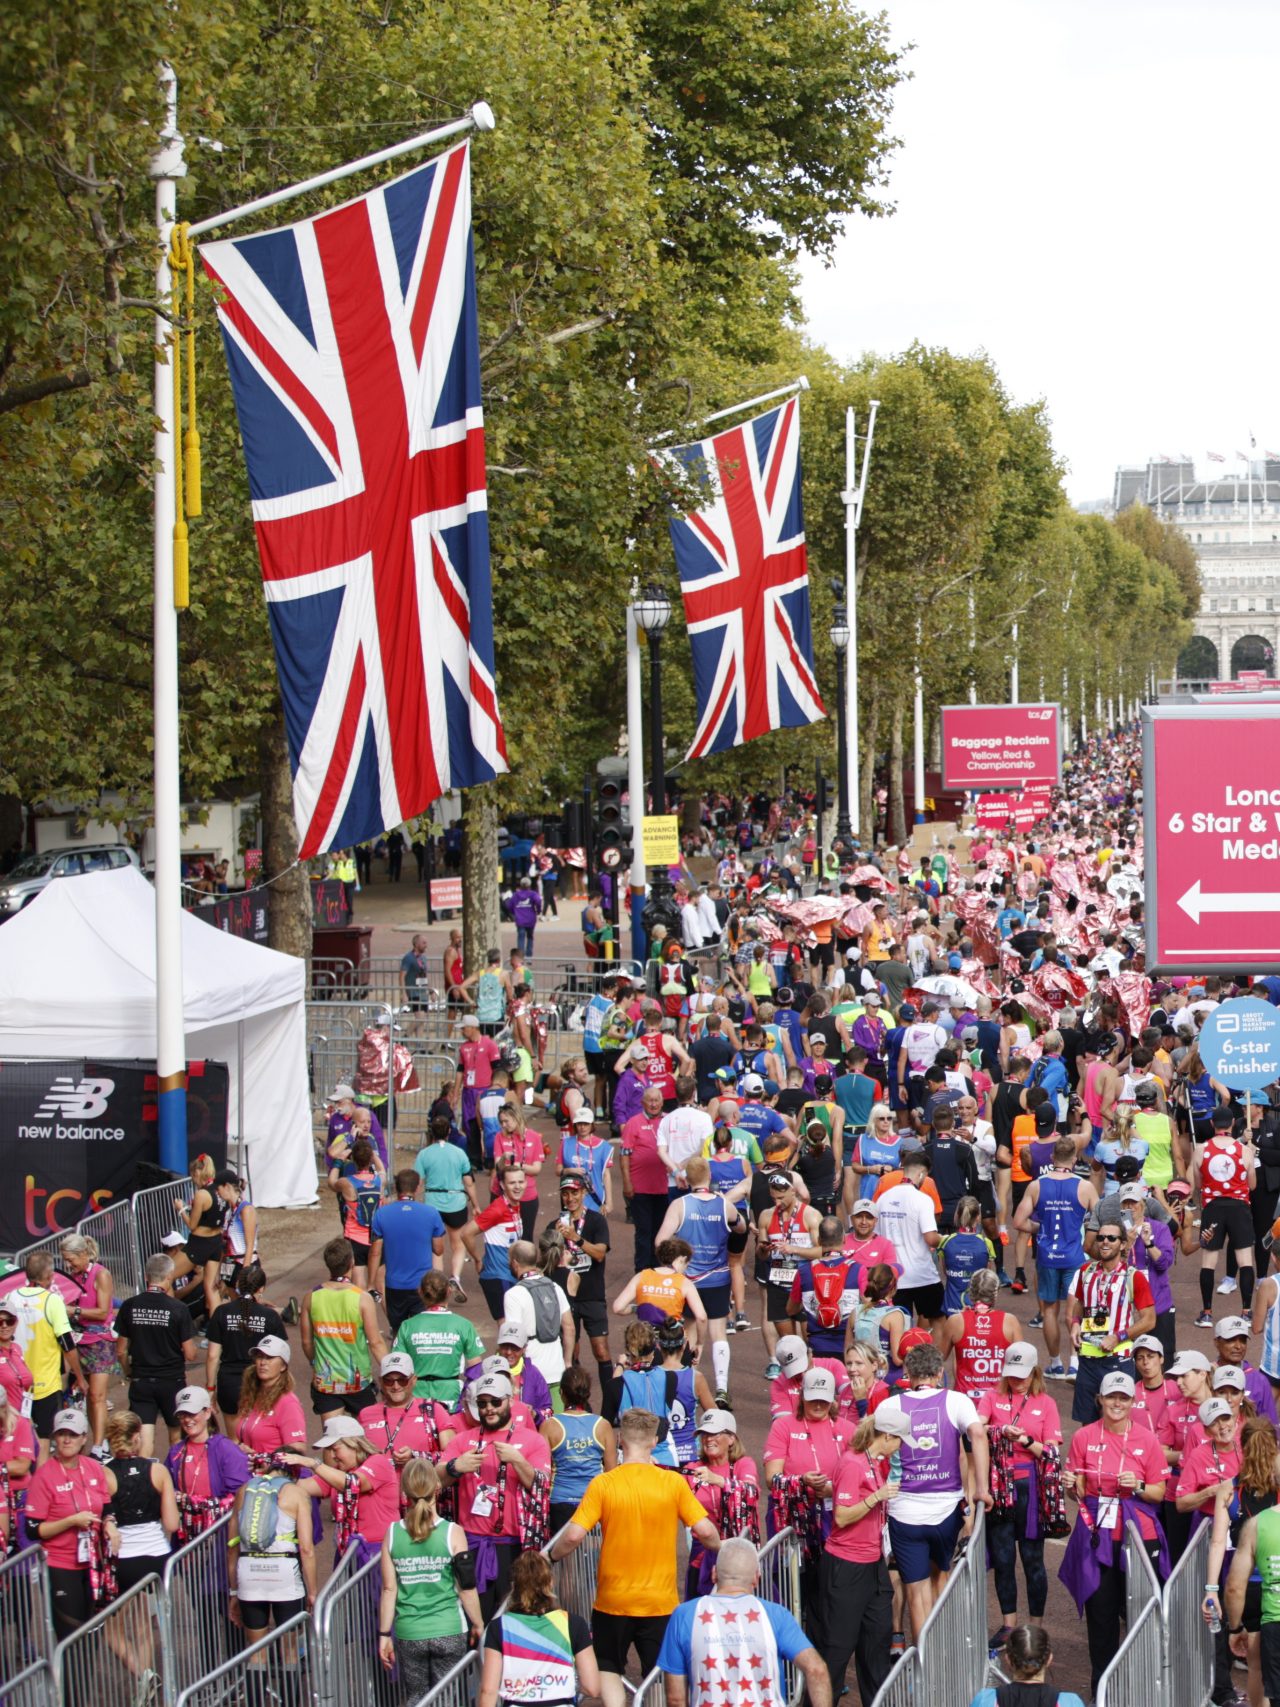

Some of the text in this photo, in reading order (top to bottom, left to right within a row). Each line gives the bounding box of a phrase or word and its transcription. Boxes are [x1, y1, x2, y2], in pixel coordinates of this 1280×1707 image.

[1028, 711, 1040, 719] tcs
[952, 736, 1049, 748] Baggage Reclaim
[971, 750, 1031, 760] Yellow, Red &
[967, 760, 1036, 770] Championship
[977, 810, 1010, 818] T-SHIRTS
[1168, 813, 1185, 834] 6
[1191, 813, 1242, 833] Star
[1249, 812, 1268, 832] &
[1222, 1038, 1271, 1054] 6-star
[1217, 1058, 1278, 1074] finisher
[18, 1123, 124, 1140] new balance
[642, 1285, 676, 1296] sense
[412, 1332, 460, 1341] MACMILLAN
[967, 1336, 986, 1346] The
[962, 1346, 1004, 1358] race is
[974, 1359, 1002, 1374] on
[913, 1423, 937, 1432] asthma
[566, 1437, 594, 1450] Look
[918, 1464, 938, 1472] TEAM
[905, 1472, 938, 1480] ASTHMA
[250, 1496, 262, 1544] NATHAN
[504, 1675, 568, 1689] RAINBOW
